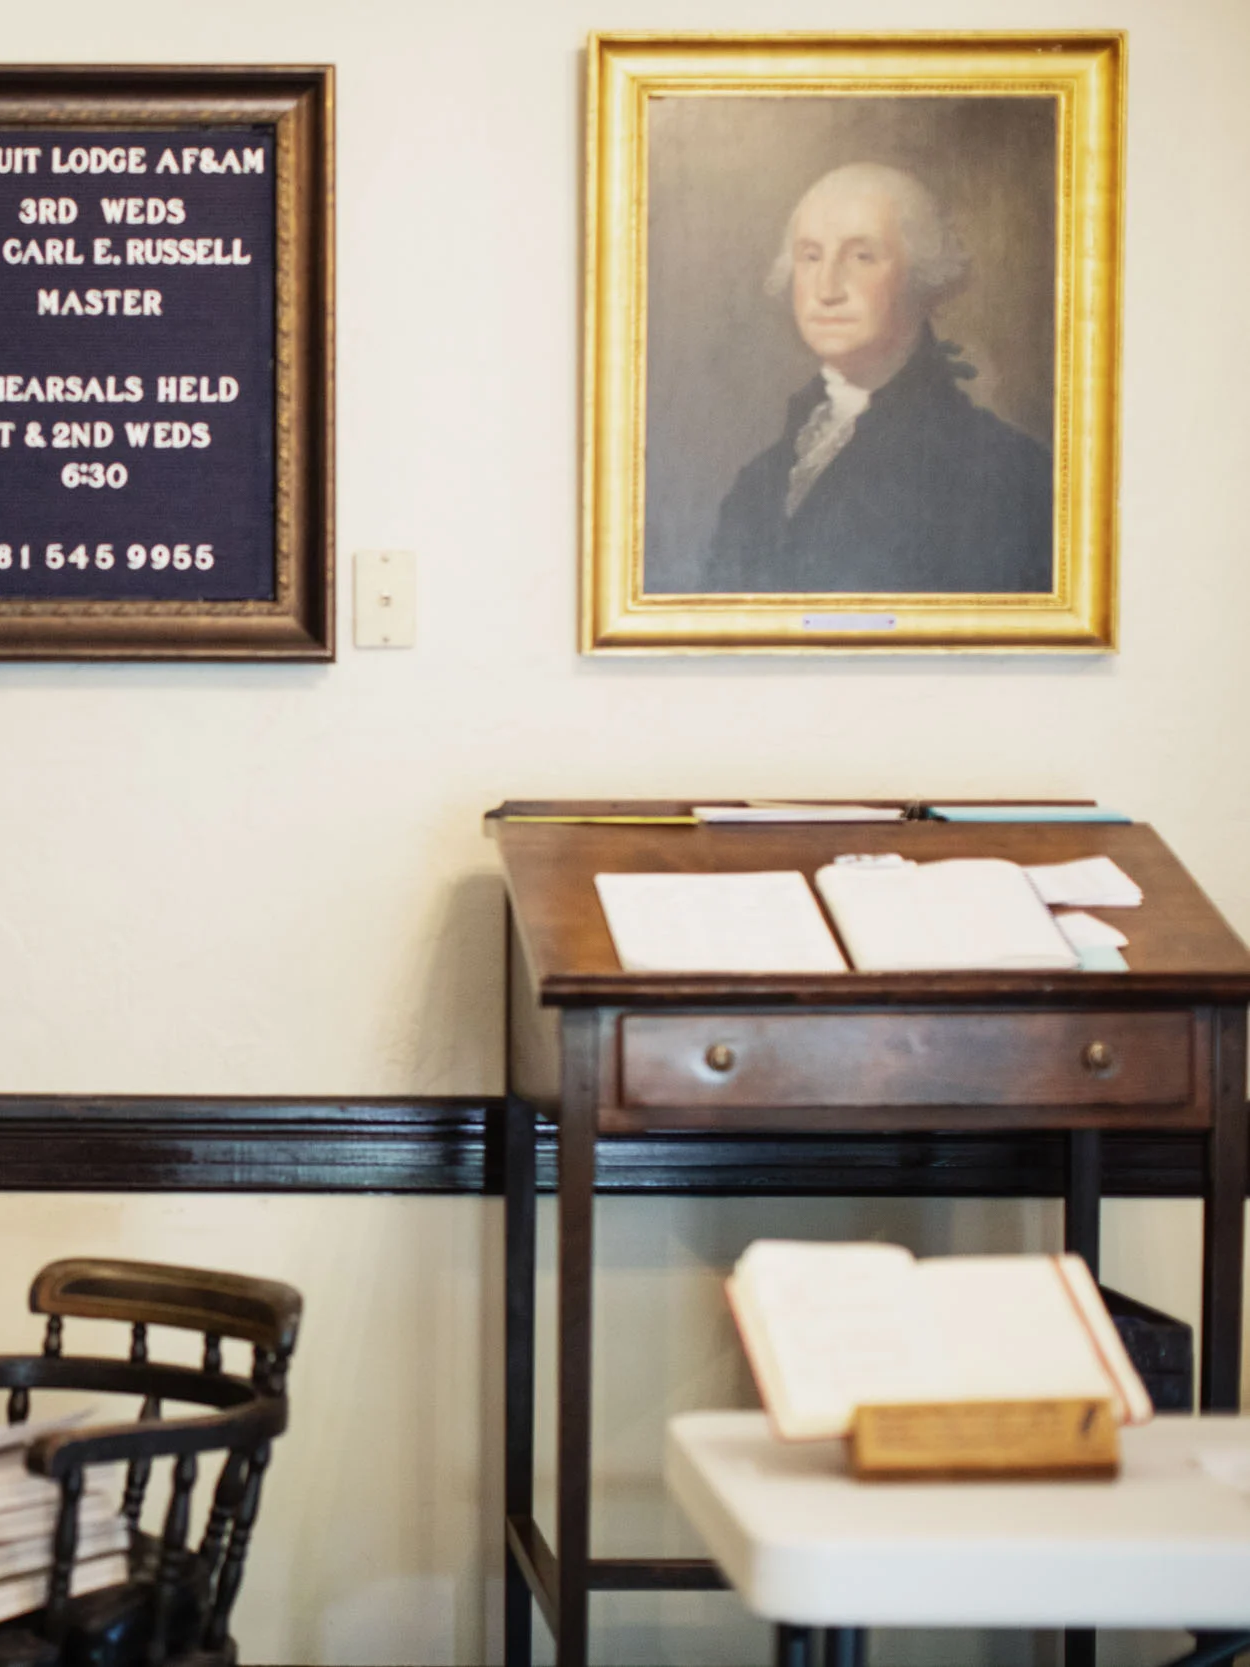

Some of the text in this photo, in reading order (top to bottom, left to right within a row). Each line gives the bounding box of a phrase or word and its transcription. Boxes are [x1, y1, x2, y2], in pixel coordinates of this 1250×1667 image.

[51, 147, 147, 175] LODGE
[155, 147, 265, 175] AF&AM
[18, 197, 186, 225] 3RD WEDS
[2, 238, 85, 265] CARL
[93, 237, 122, 266] E.
[126, 238, 252, 266] RUSSELL
[37, 289, 162, 317] MASTER
[157, 375, 239, 403] HELD
[24, 421, 47, 449] &
[51, 421, 114, 449] 2ND
[124, 421, 212, 449] WEDS
[61, 462, 129, 489] 6:30
[45, 543, 115, 570] 545
[126, 543, 215, 571] 9955
